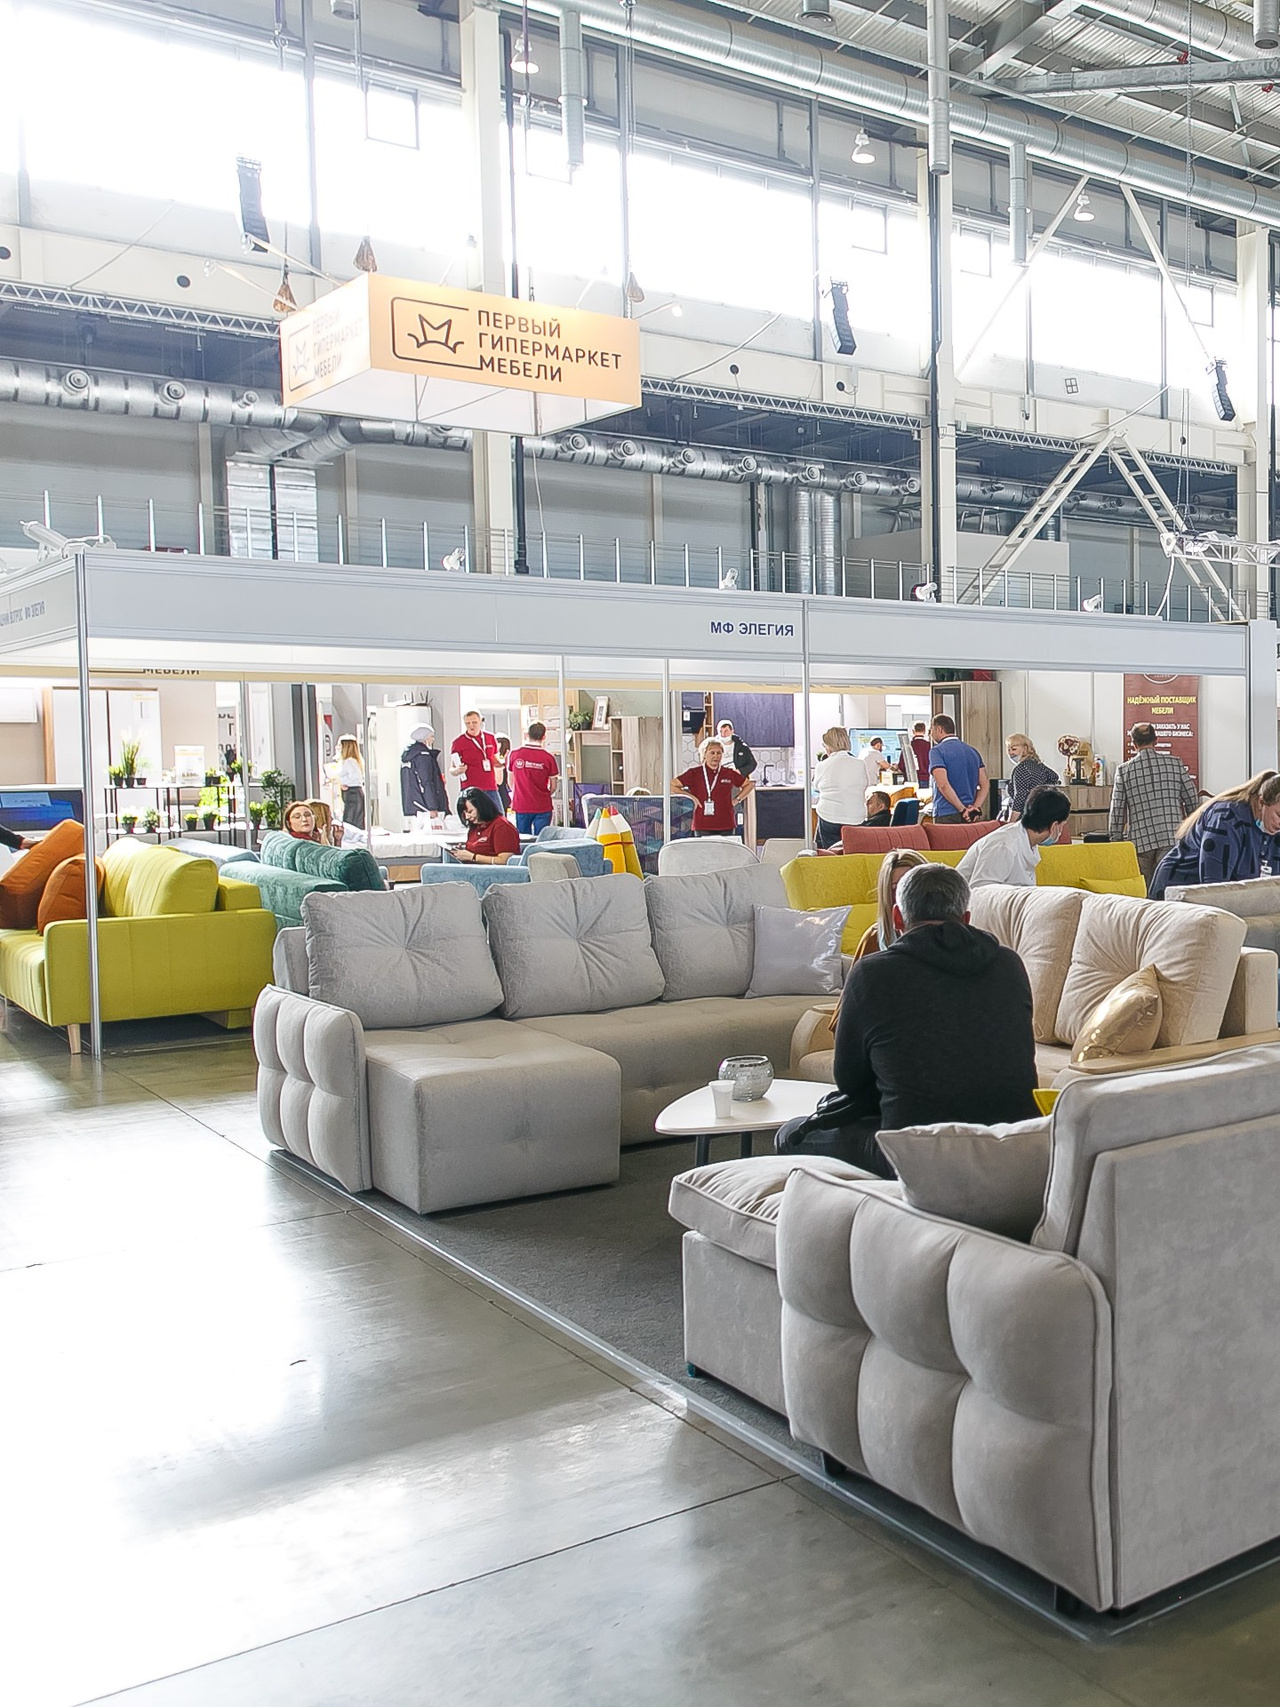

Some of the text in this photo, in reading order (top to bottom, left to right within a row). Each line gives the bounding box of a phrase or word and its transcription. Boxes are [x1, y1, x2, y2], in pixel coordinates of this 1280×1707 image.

[478, 310, 561, 338] ПЕРВЫЙ
[479, 332, 622, 370] ГИПЕРМАРКЕТ
[314, 352, 342, 379] МЕБЕЛИ
[479, 354, 563, 383] МЕБЕЛИ
[710, 621, 794, 636] МФ ЭЛЕГИЯ
[1151, 706, 1174, 715] МЕБЕЛИ
[1161, 696, 1196, 704] ПОСТАВЩИК
